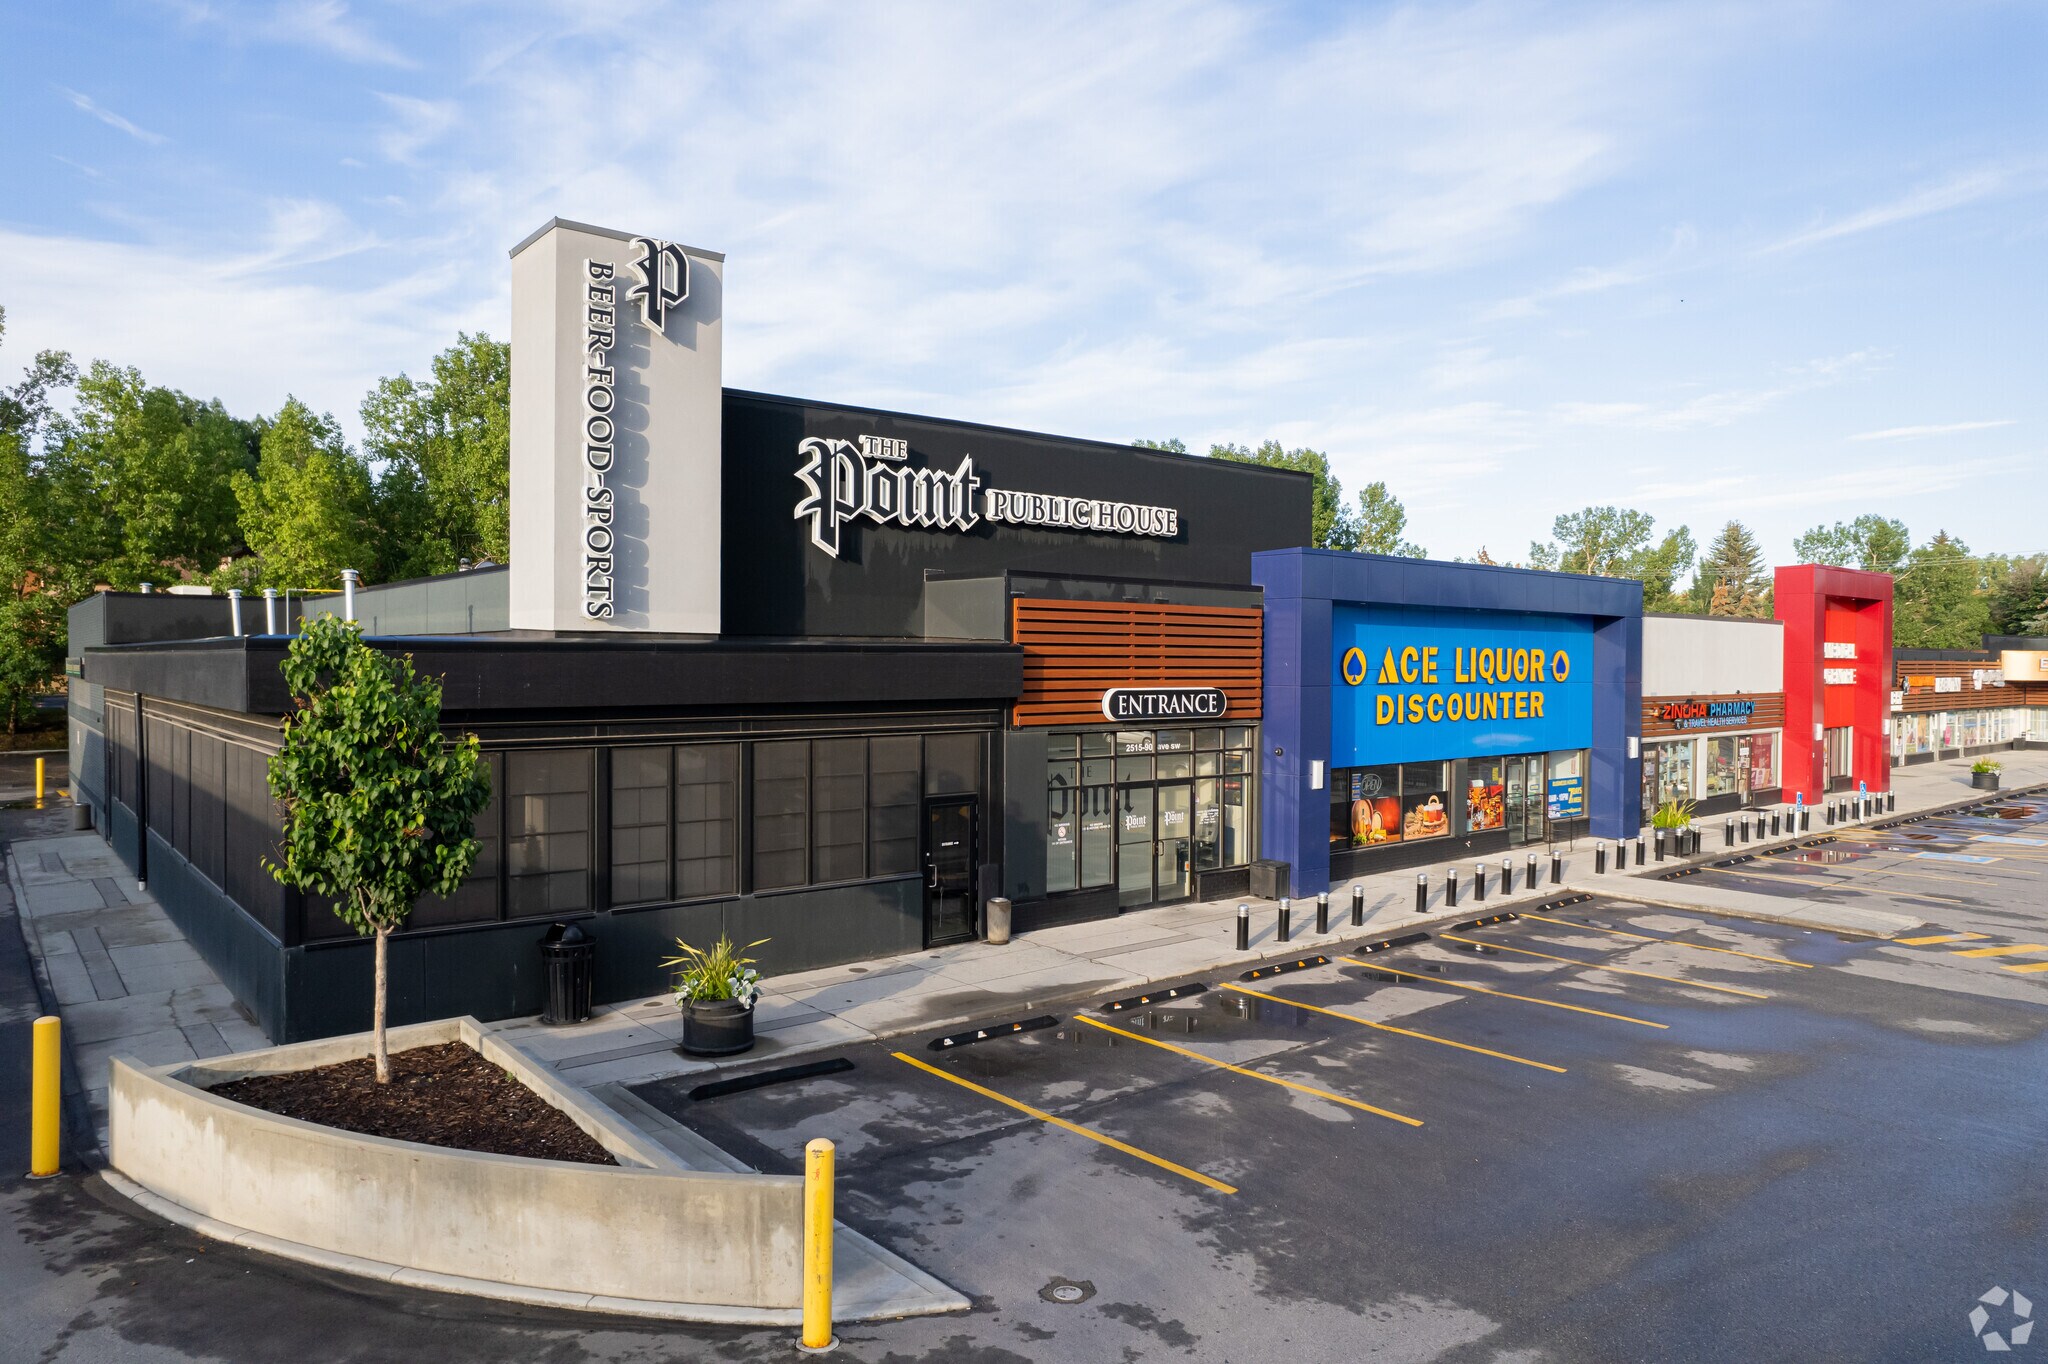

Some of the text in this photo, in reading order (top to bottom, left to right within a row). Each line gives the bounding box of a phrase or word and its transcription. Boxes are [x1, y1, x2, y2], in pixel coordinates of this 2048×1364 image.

[859, 434, 908, 461] THE
[794, 436, 981, 559] Point
[985, 488, 1179, 537] PUBLIC HOUSE
[1377, 646, 1546, 685] ACE LIQUOR
[1117, 693, 1218, 716] ENTRANCE
[1375, 691, 1545, 726] DISCOUNTER
[1710, 701, 1756, 716] PHARMACY
[1688, 718, 1706, 728] TRAVEL
[1707, 717, 1725, 726] HEALTH
[1726, 715, 1748, 724] SERVICES
[1361, 777, 1382, 791] OPEN
